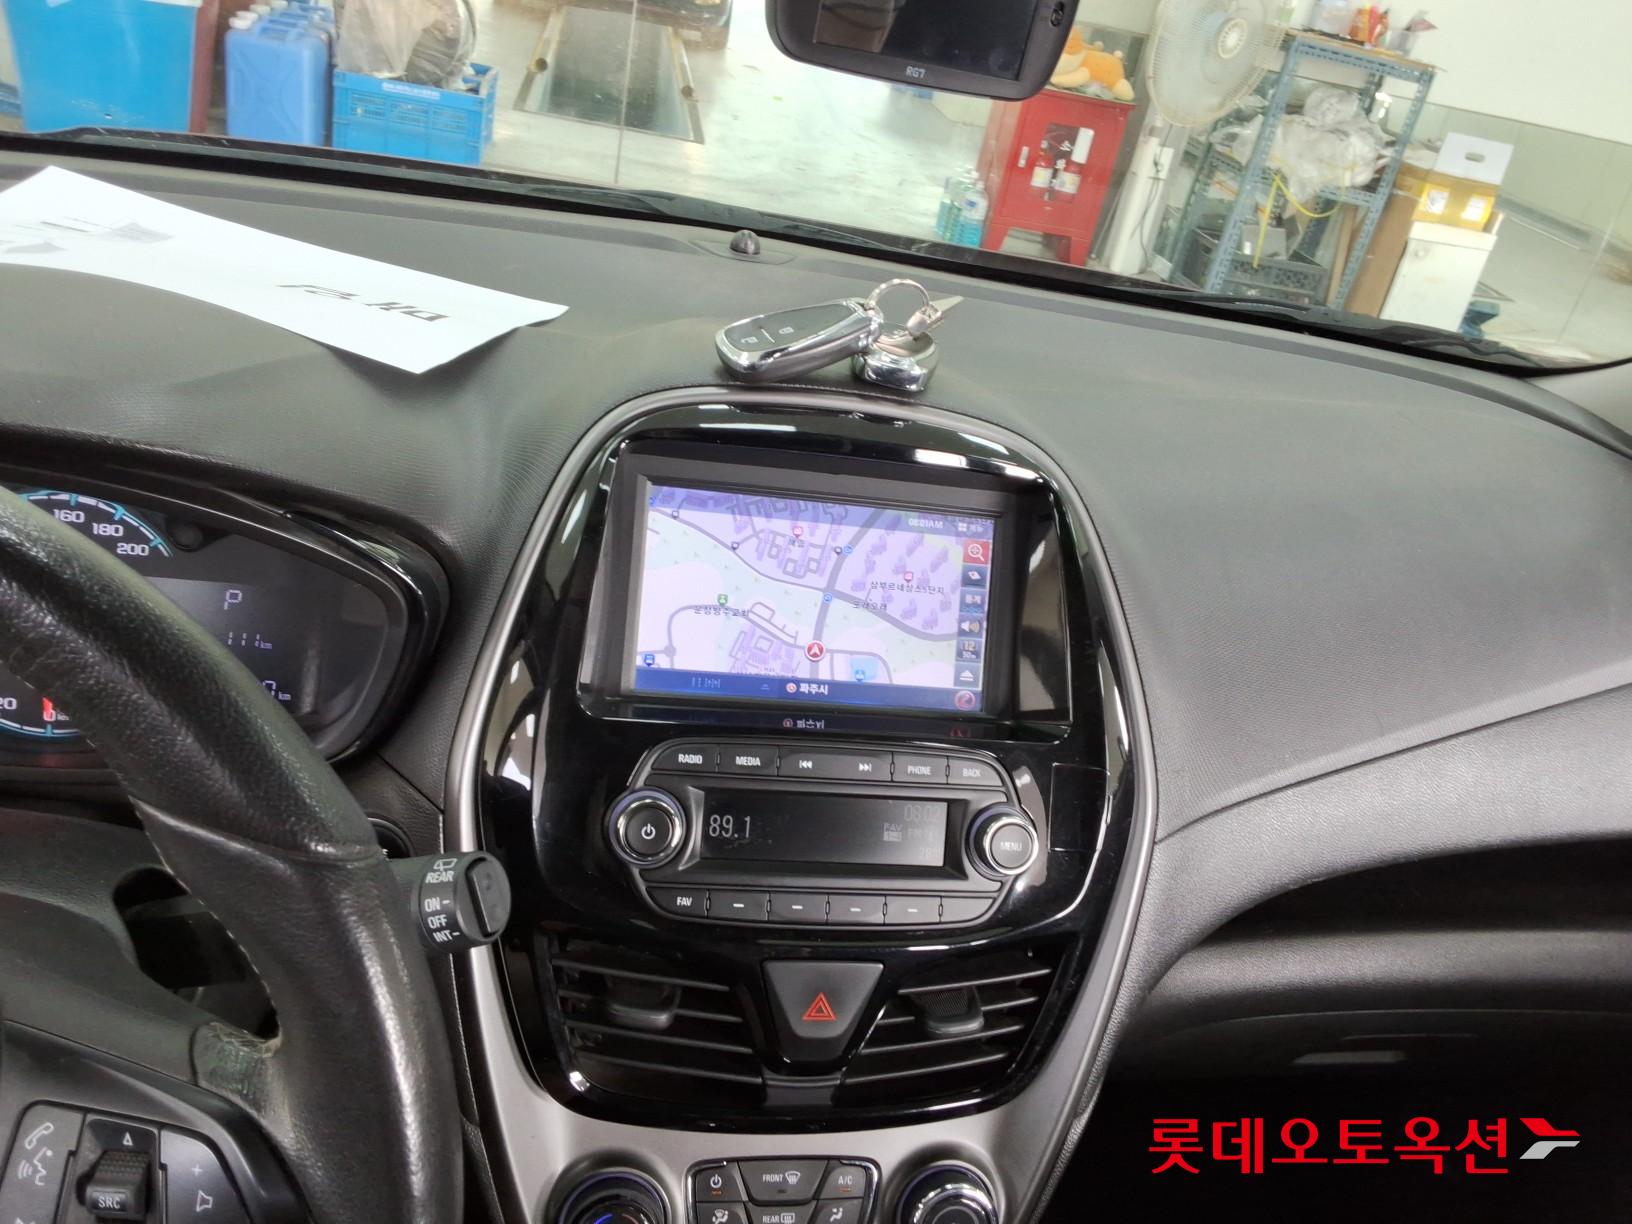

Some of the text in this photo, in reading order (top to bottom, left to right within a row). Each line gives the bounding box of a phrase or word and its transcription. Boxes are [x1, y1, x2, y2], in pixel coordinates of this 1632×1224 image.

[53, 509, 85, 523] 160
[92, 522, 124, 537] 180
[116, 542, 149, 556] 200
[223, 589, 242, 610] P
[799, 682, 829, 695] 파주시
[678, 753, 703, 765] RADIO
[735, 756, 761, 766] MEDIA
[907, 764, 932, 776] PHONE
[962, 767, 981, 777] BACK
[709, 814, 751, 838] 89.1
[1000, 840, 1022, 851] MENU
[425, 870, 455, 884] REAR
[424, 897, 441, 912] ON
[676, 896, 693, 907] FAV
[427, 914, 448, 929] OFF
[432, 930, 453, 942] INT
[762, 1173, 783, 1183] FRONT
[837, 1175, 853, 1185] A/C
[98, 1195, 121, 1209] SRC
[762, 1215, 780, 1224] REAR
